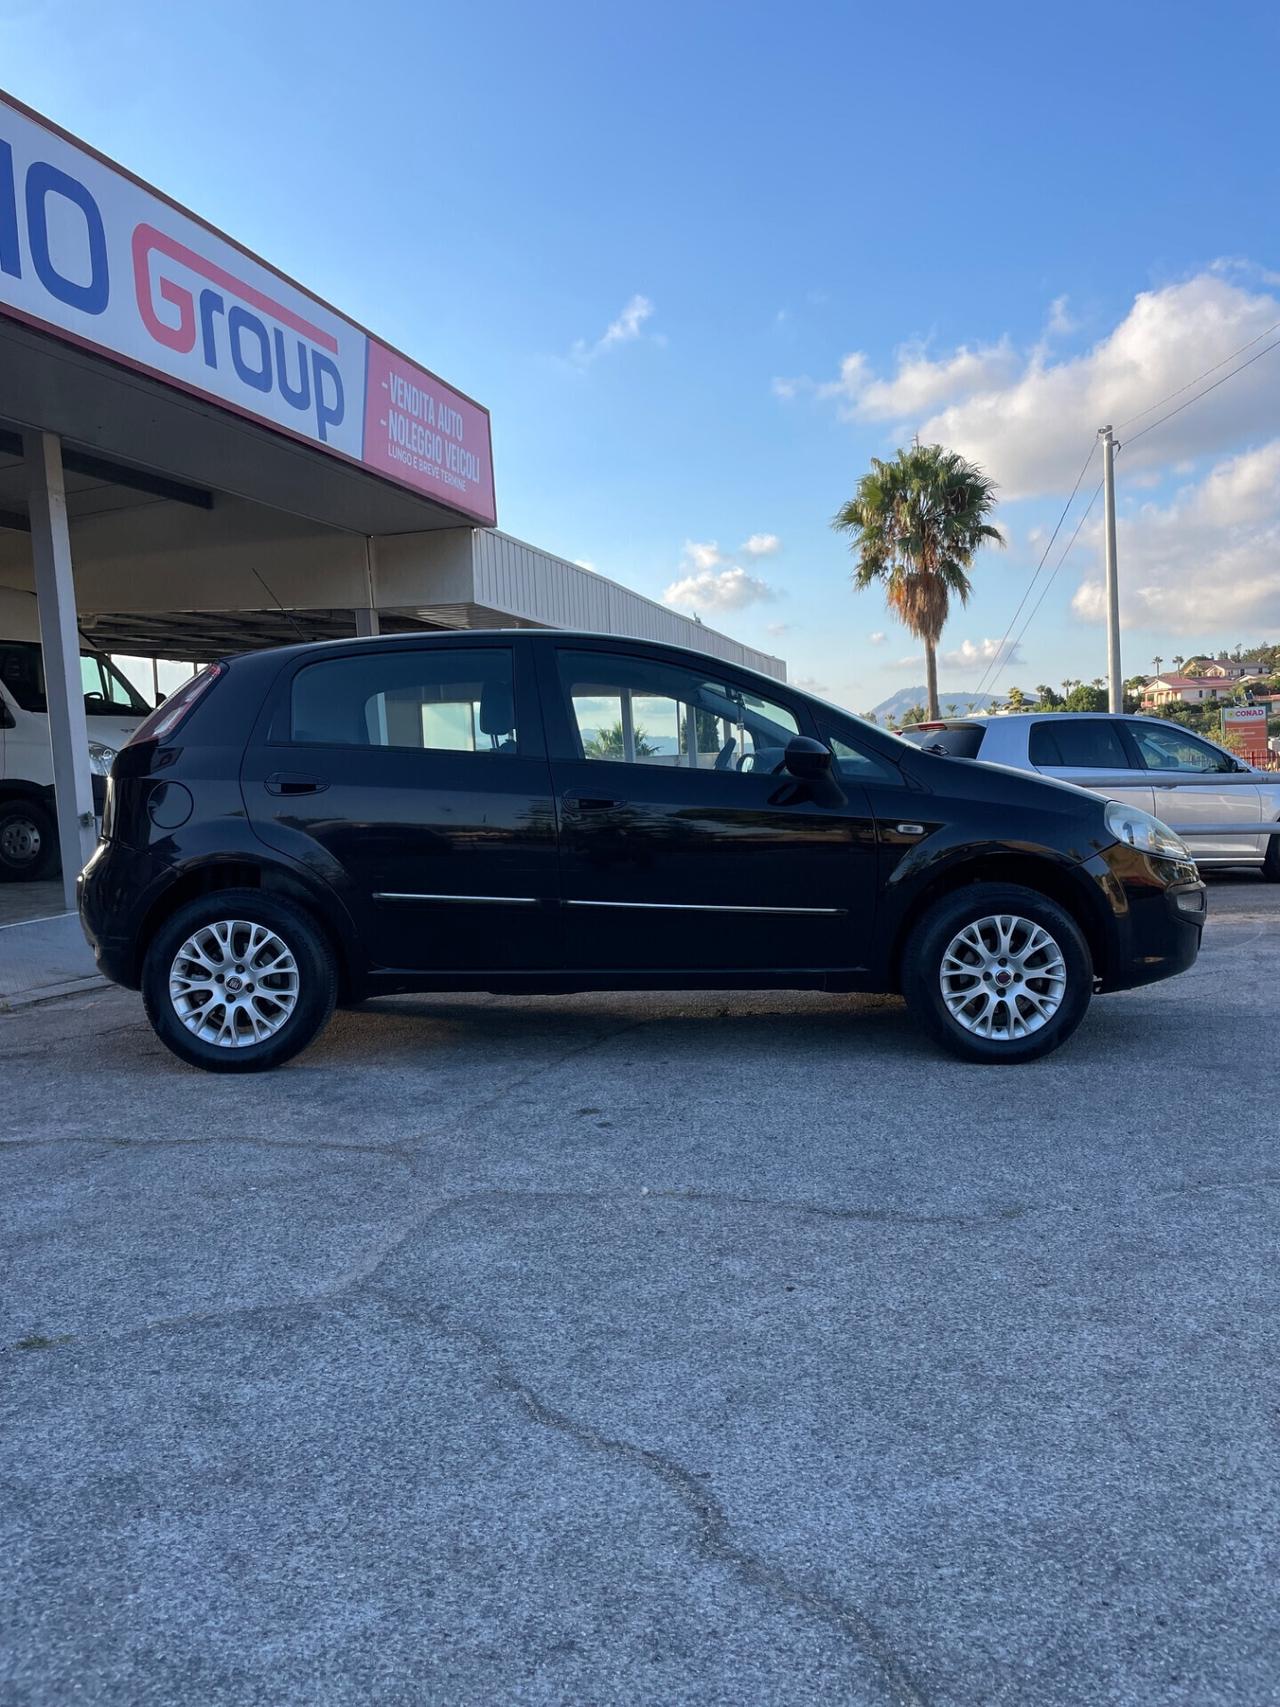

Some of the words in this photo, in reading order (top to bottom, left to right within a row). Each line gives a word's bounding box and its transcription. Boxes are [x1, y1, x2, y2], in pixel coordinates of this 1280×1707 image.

[132, 222, 344, 441] Group
[438, 404, 463, 442] AUTO
[388, 443, 412, 468] LUNGO
[418, 459, 440, 479] BREVE
[440, 469, 467, 492] TERMINE
[444, 439, 480, 484] VEICOLI
